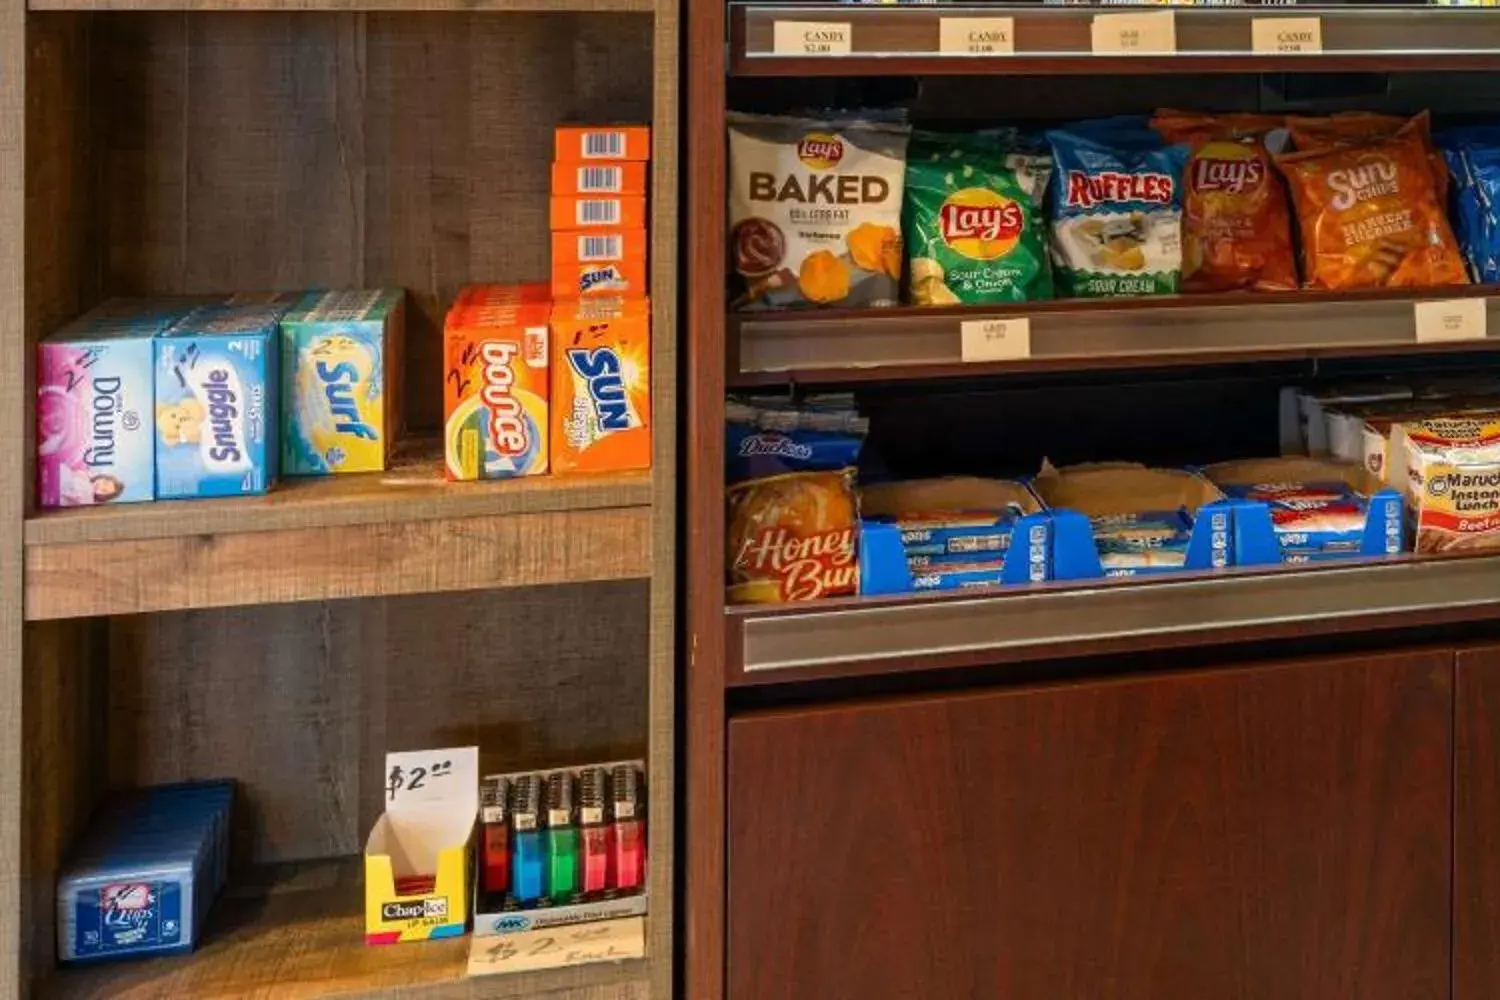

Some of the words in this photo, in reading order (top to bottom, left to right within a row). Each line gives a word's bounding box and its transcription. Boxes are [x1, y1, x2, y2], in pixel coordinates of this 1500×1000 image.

[804, 31, 845, 42] CANDY
[750, 173, 890, 205] BAKED
[1069, 170, 1174, 207] RUFFLES
[1197, 159, 1262, 192] Lay's
[1327, 161, 1397, 210] Sun
[947, 202, 1018, 240] Lay's
[580, 268, 614, 291] SUN
[1088, 279, 1116, 293] SOUR
[1118, 279, 1155, 293] CREAM
[316, 360, 379, 441] Surf
[481, 340, 528, 457] bounce
[568, 346, 630, 432] SUN
[84, 376, 121, 468] Downy
[202, 368, 241, 463] Snuggle
[1455, 500, 1499, 512] Lunch
[736, 529, 854, 570] Honey
[782, 558, 860, 600] Bun
